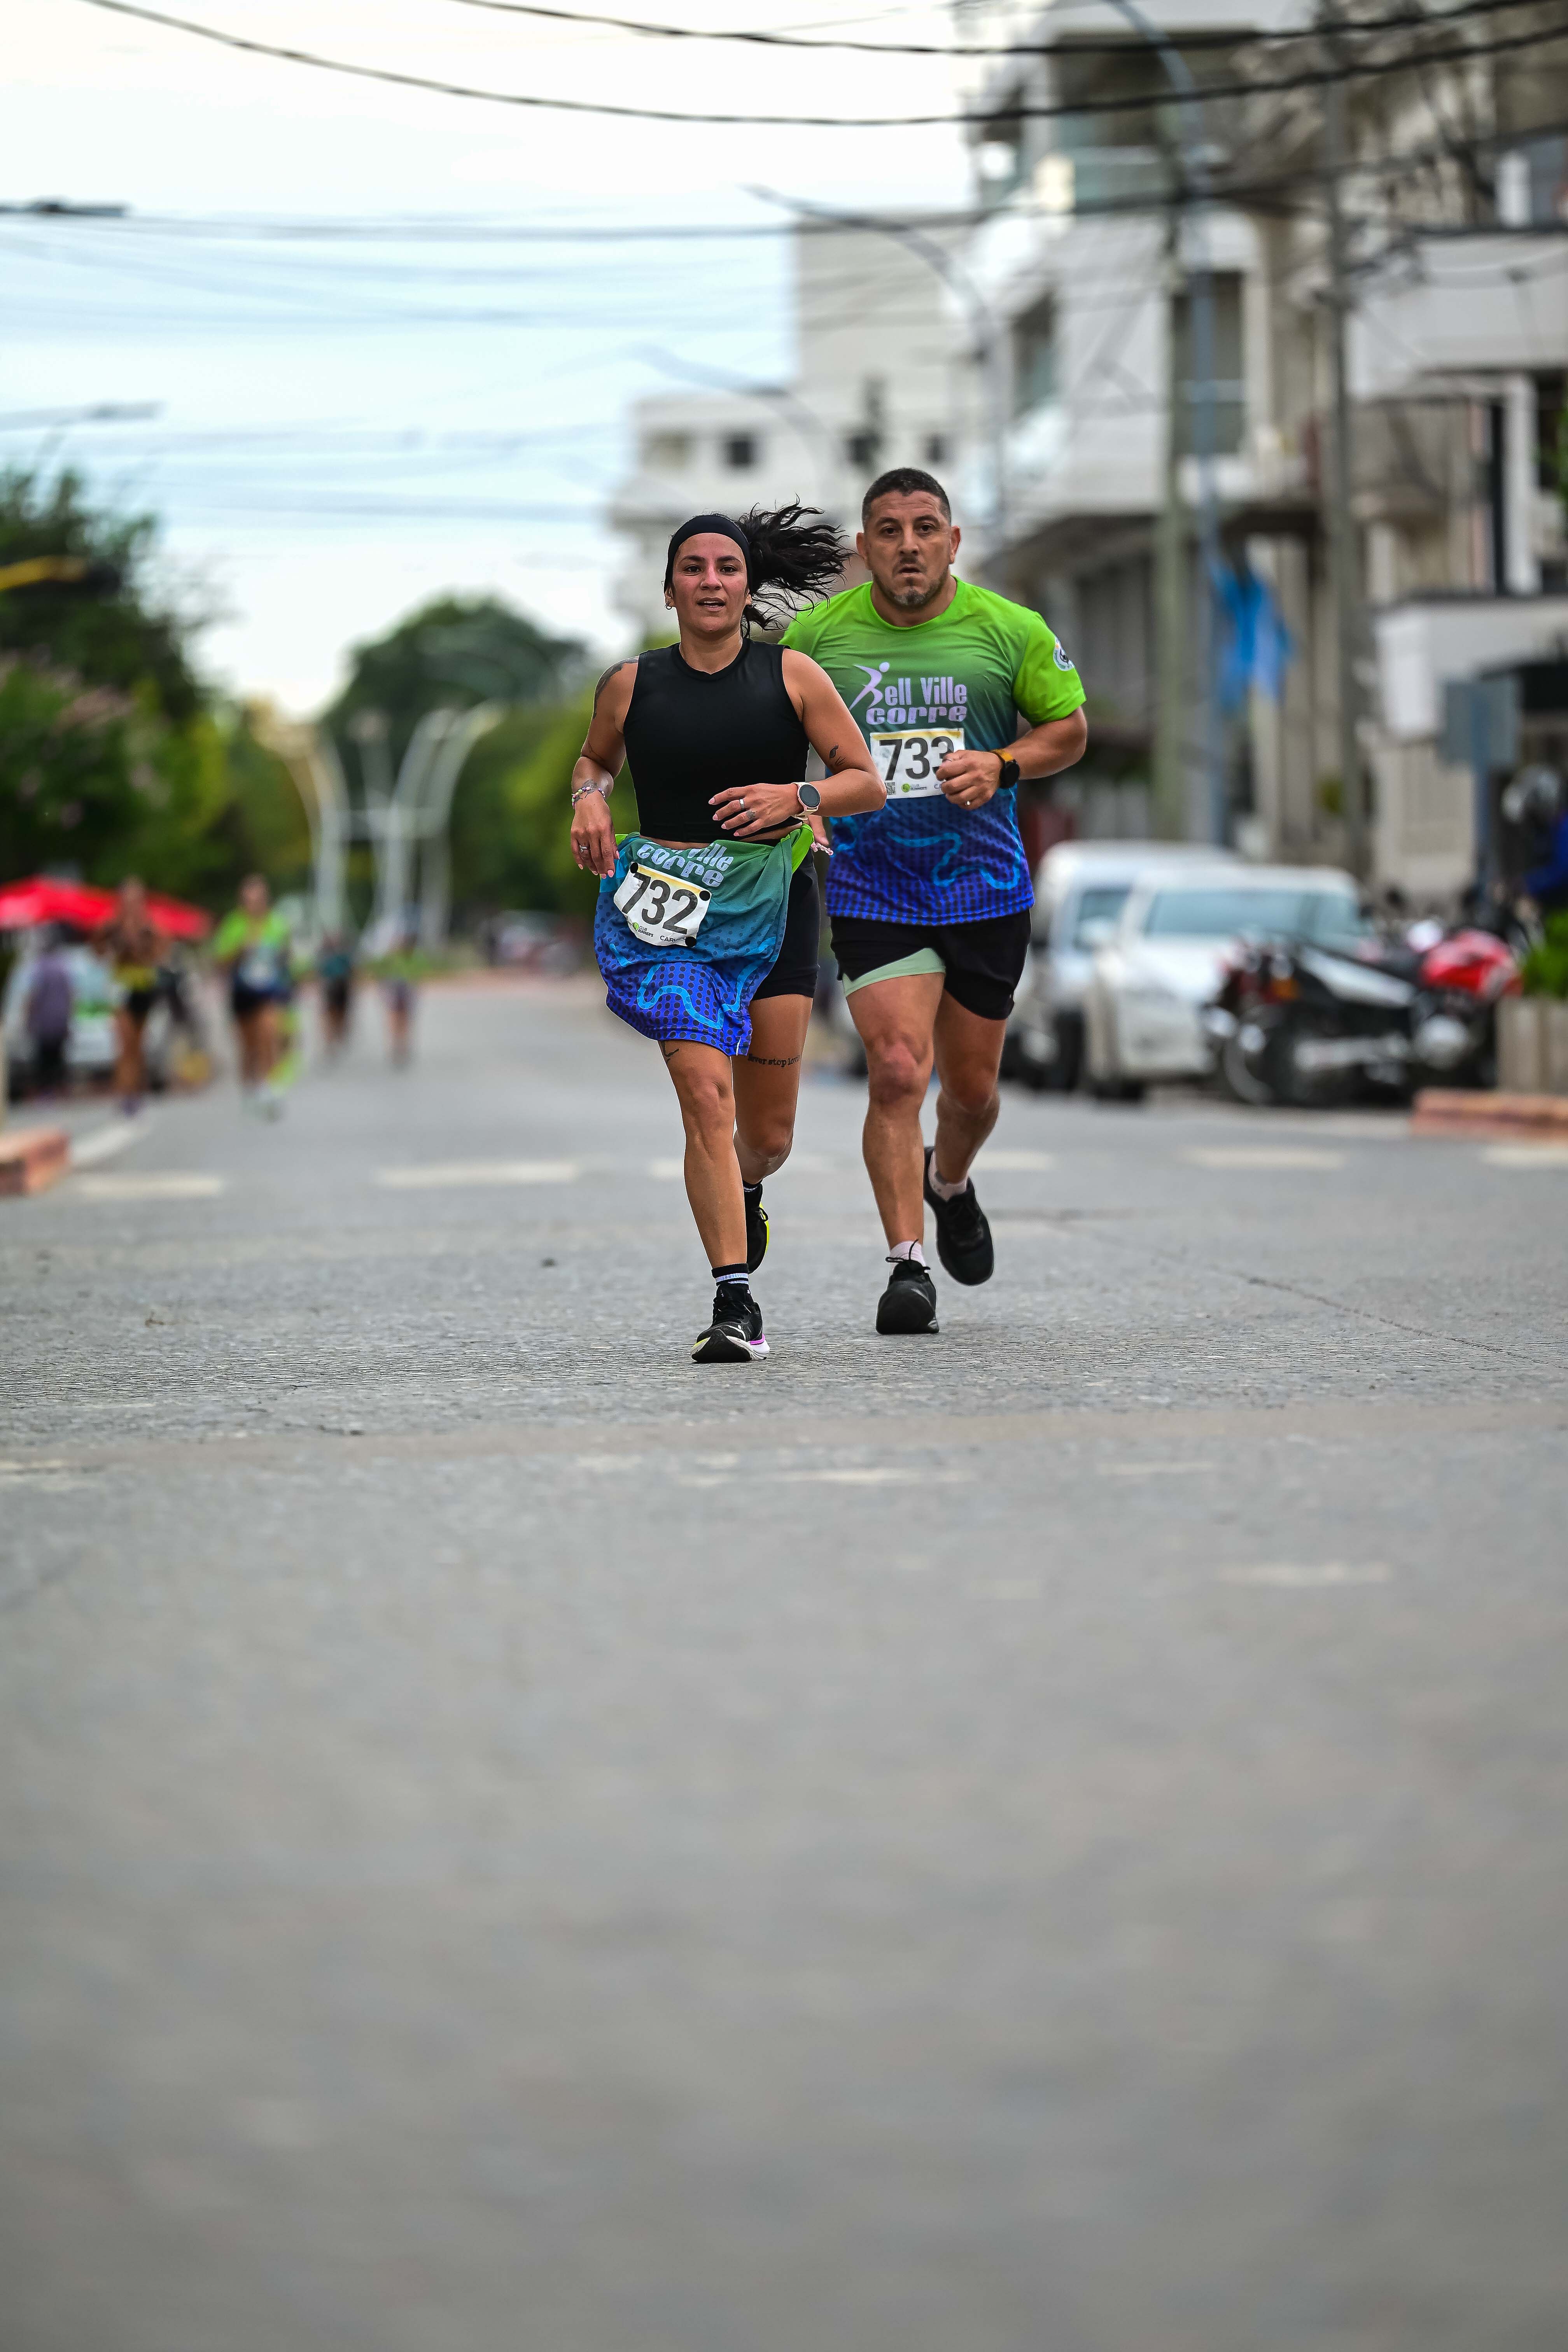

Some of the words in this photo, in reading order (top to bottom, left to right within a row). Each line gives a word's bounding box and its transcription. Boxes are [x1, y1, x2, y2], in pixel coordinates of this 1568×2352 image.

[920, 676, 968, 705] Ville
[866, 706, 967, 724] corre
[637, 844, 724, 887] corre
[621, 872, 698, 935] 732
